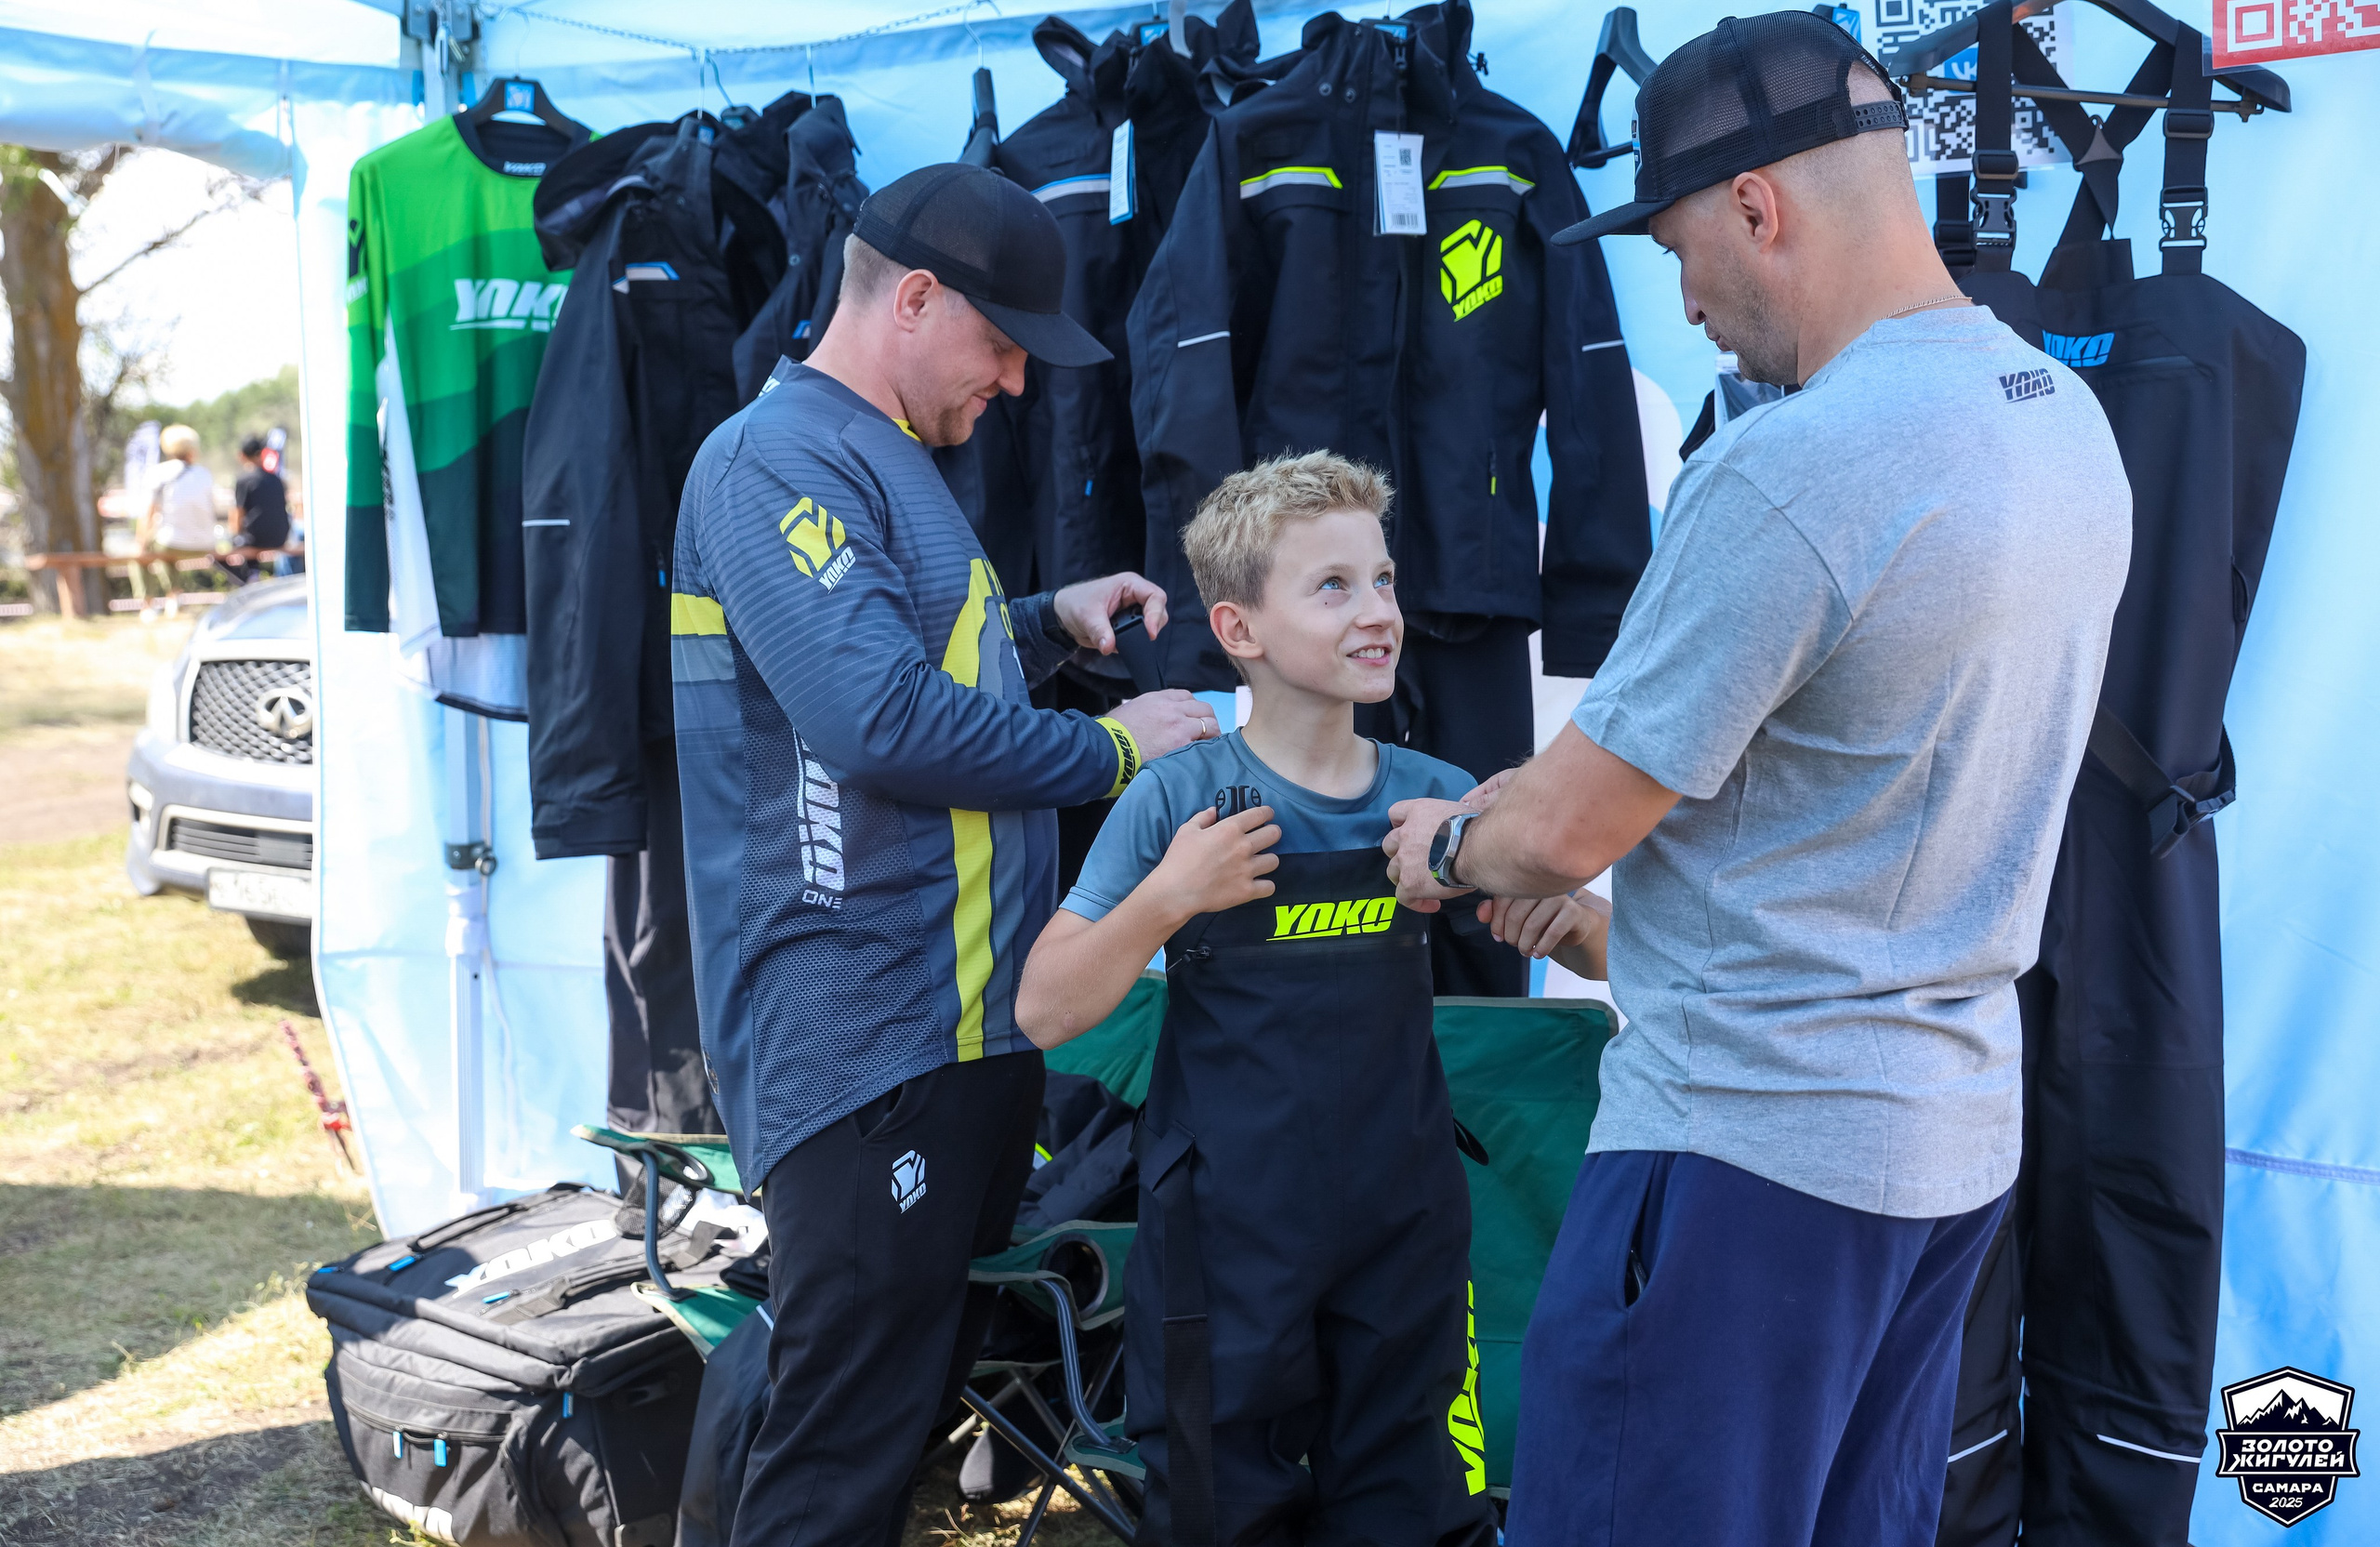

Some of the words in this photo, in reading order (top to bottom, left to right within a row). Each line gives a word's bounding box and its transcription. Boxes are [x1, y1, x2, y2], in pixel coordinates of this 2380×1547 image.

[450, 278, 570, 332] YOK
[1452, 275, 1503, 323] YOKO
[1999, 368, 2056, 403] YOKO
[819, 546, 855, 595] YOKO
[793, 727, 845, 891] OKO
[801, 889, 843, 910] ONE
[1265, 896, 1397, 941] YOKO
[899, 1182, 927, 1214] YOKO
[444, 1219, 618, 1300] YOKO
